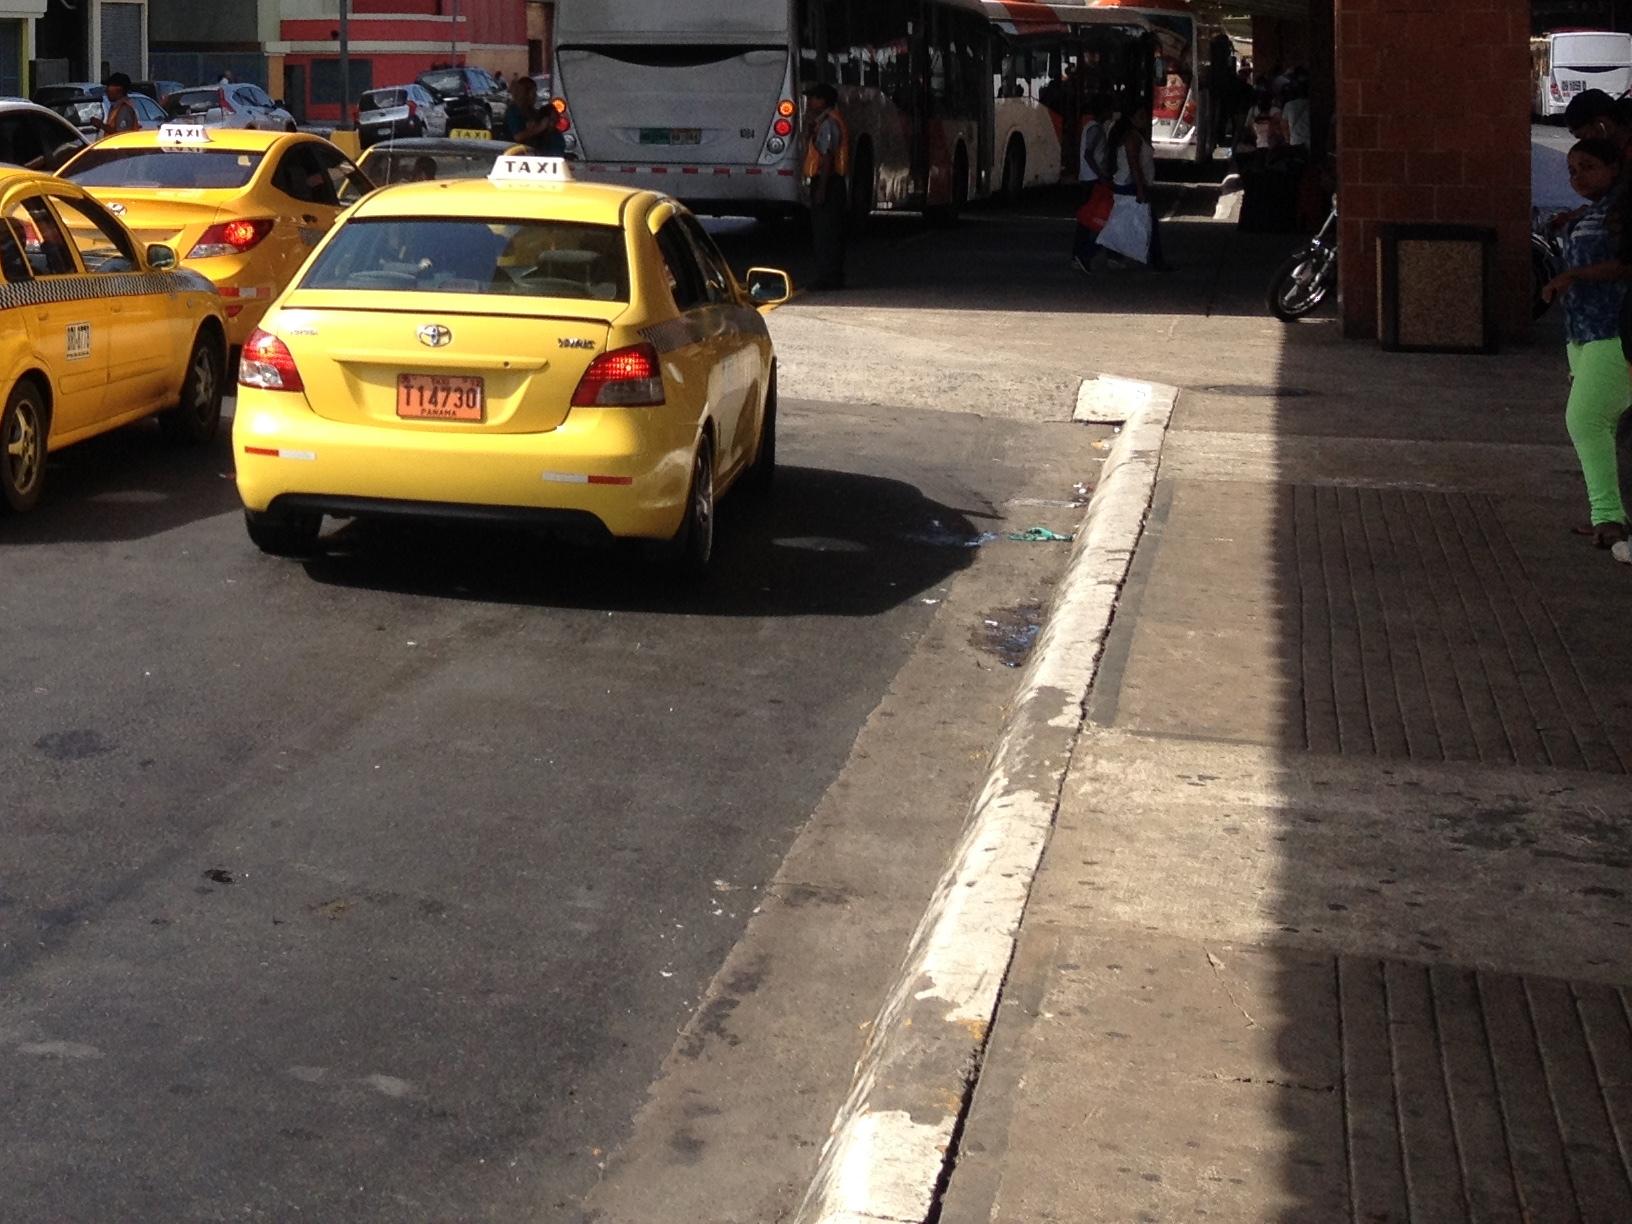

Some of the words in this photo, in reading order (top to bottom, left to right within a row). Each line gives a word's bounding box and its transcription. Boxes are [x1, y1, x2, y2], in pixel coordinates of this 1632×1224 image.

[164, 128, 200, 137] TAXI
[456, 131, 488, 139] TAXI
[504, 160, 558, 174] TAXI
[403, 384, 477, 409] T14730
[420, 408, 458, 417] PANAMA
